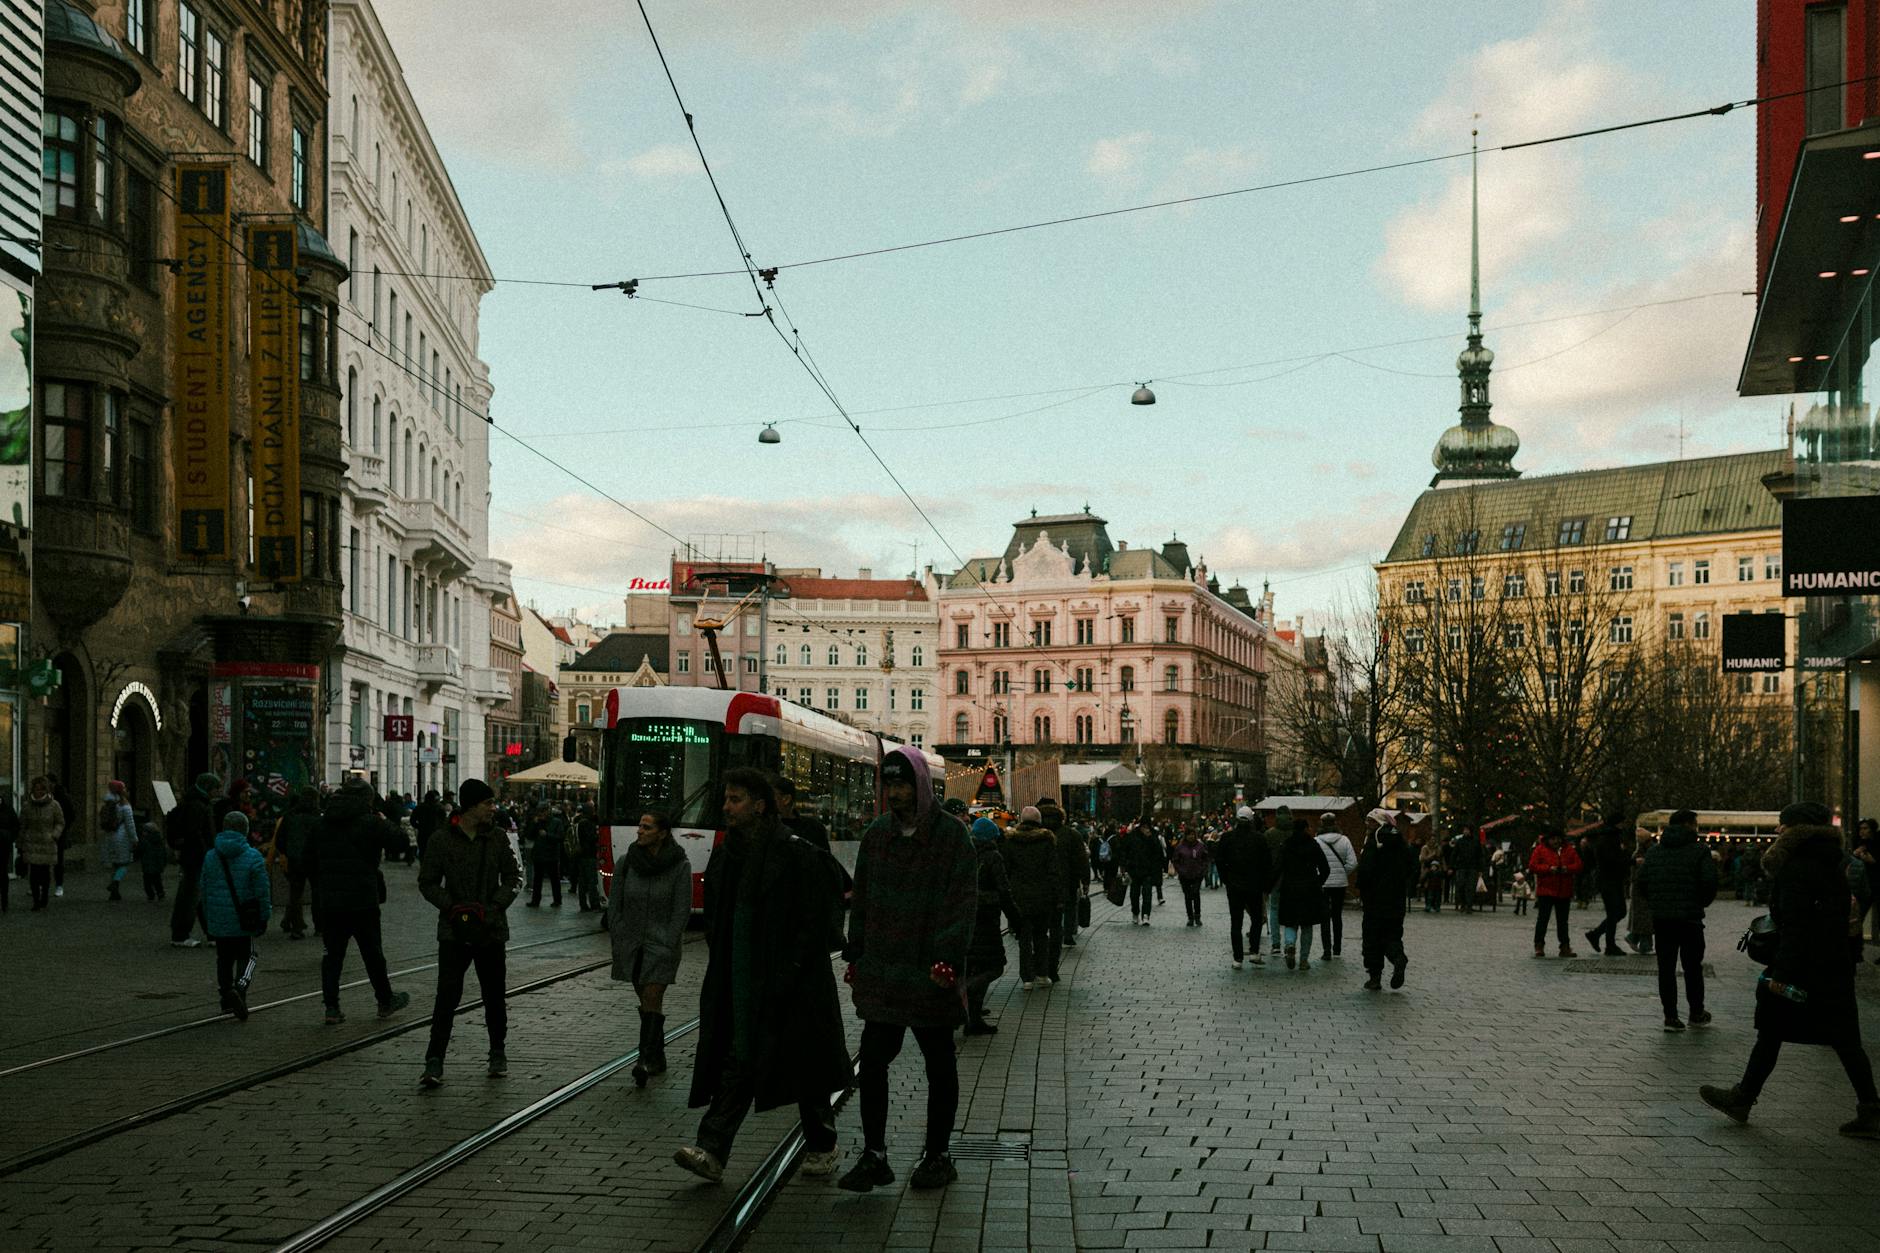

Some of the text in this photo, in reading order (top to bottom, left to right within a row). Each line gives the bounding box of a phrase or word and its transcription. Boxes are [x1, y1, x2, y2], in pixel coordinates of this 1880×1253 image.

[187, 238, 207, 485] STUDENT AGENCY
[262, 463, 284, 527] DŮM
[1790, 571, 1880, 589] HUMANIC
[1726, 658, 1782, 669] HUMANIC
[392, 719, 407, 737] T
